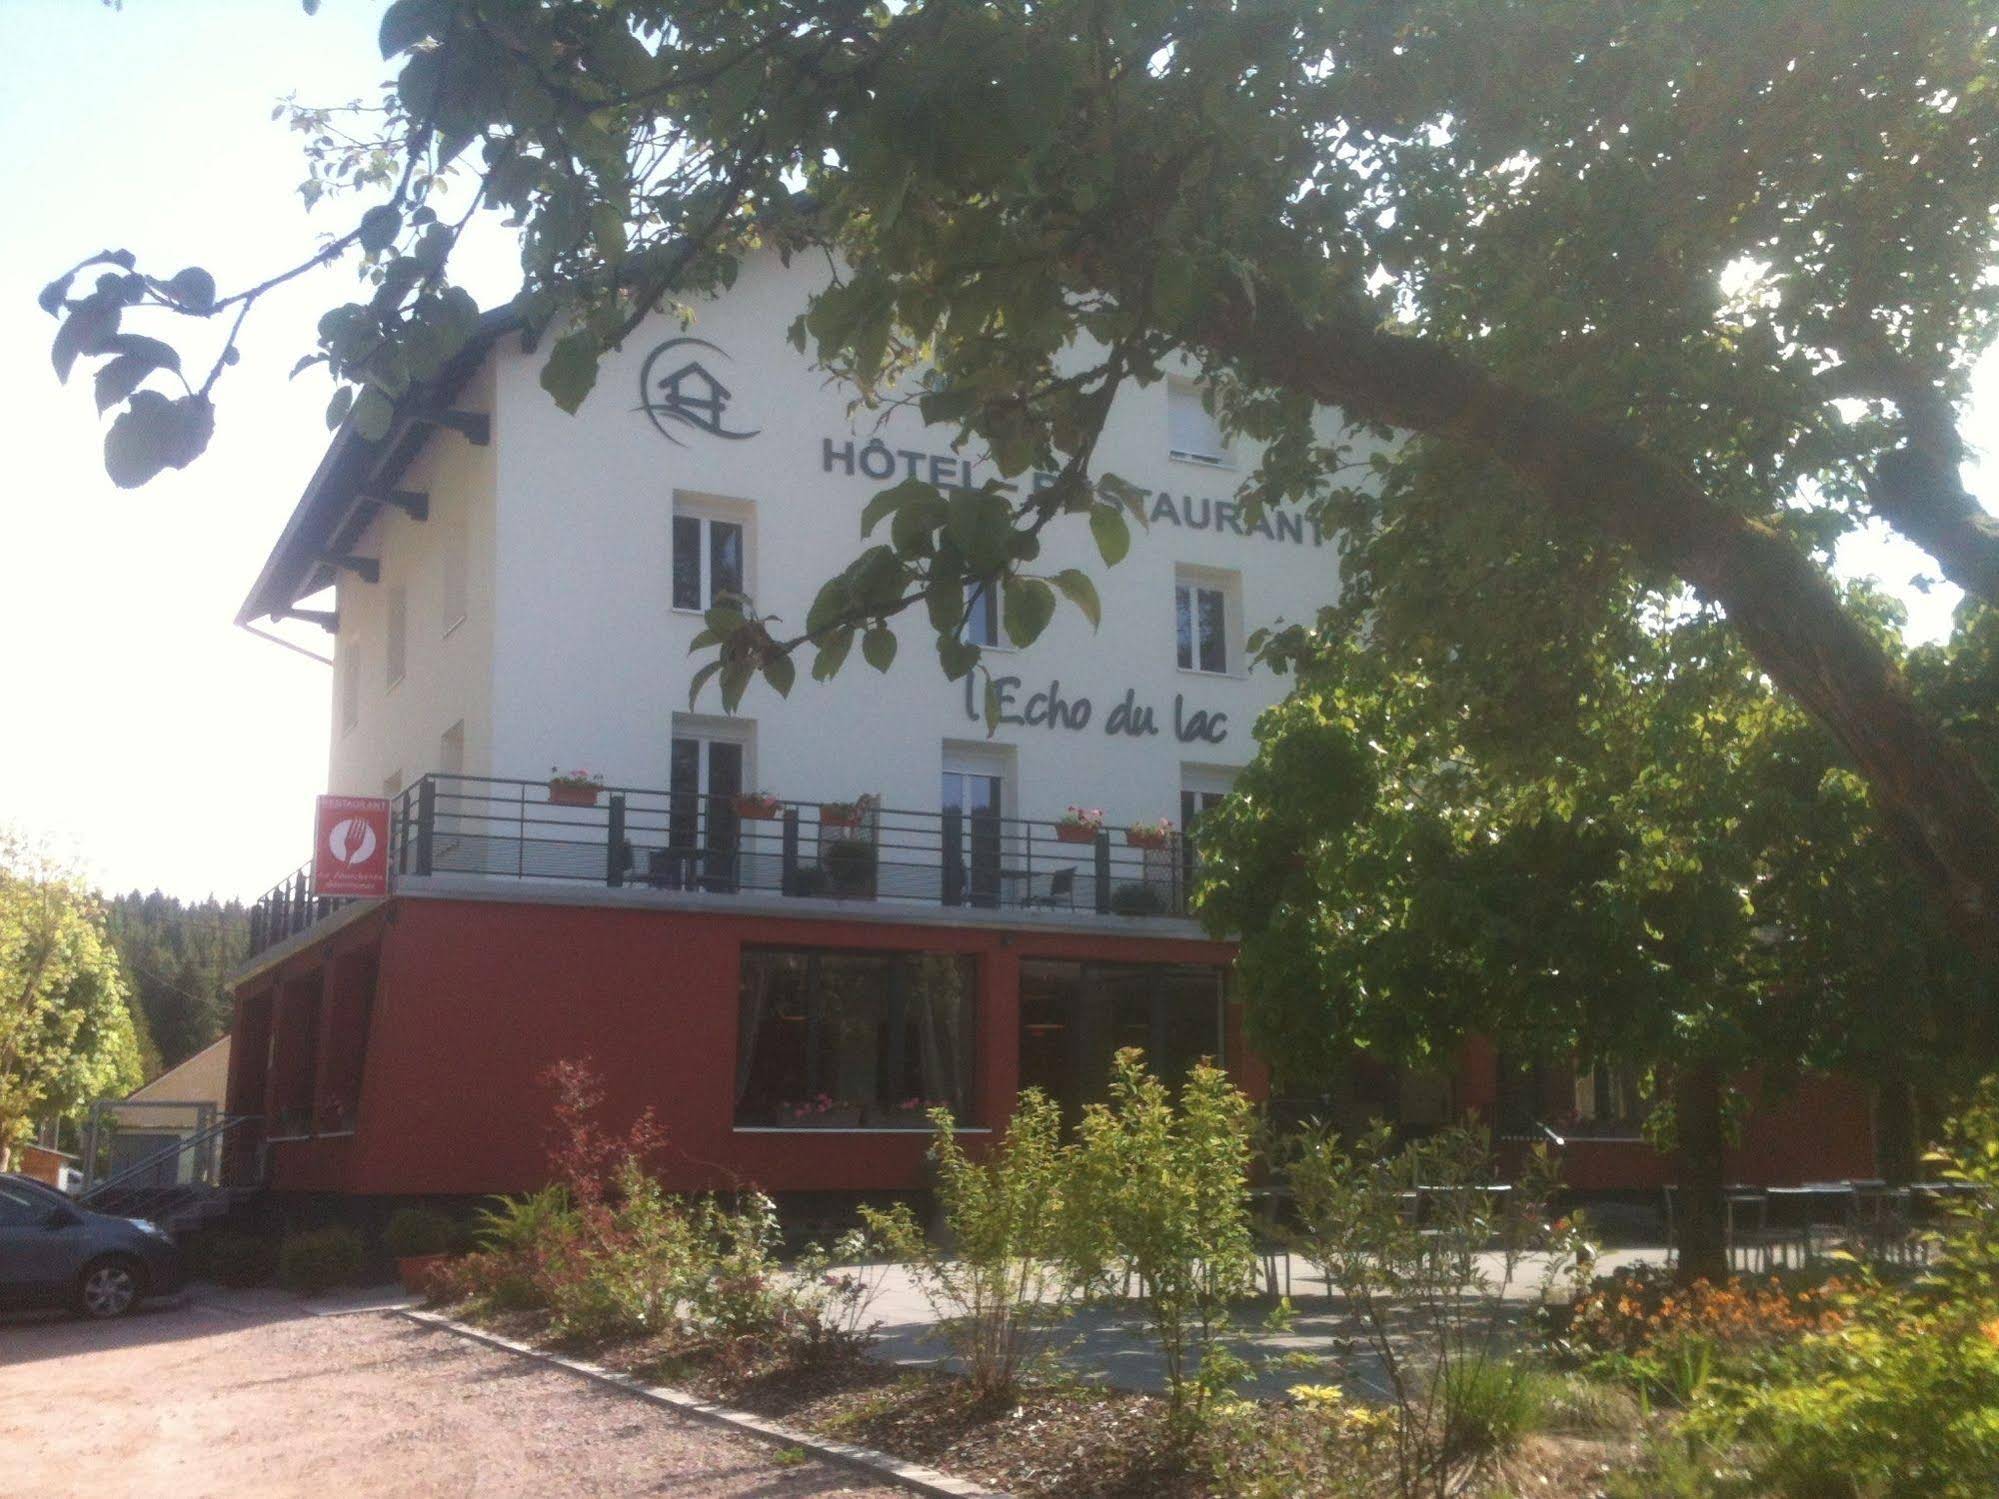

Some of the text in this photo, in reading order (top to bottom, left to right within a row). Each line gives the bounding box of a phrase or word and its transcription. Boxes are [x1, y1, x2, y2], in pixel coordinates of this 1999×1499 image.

[822, 438, 983, 494] HÔTEL
[1032, 471, 1325, 547] AURANT
[964, 669, 1229, 744] lEcho du lac
